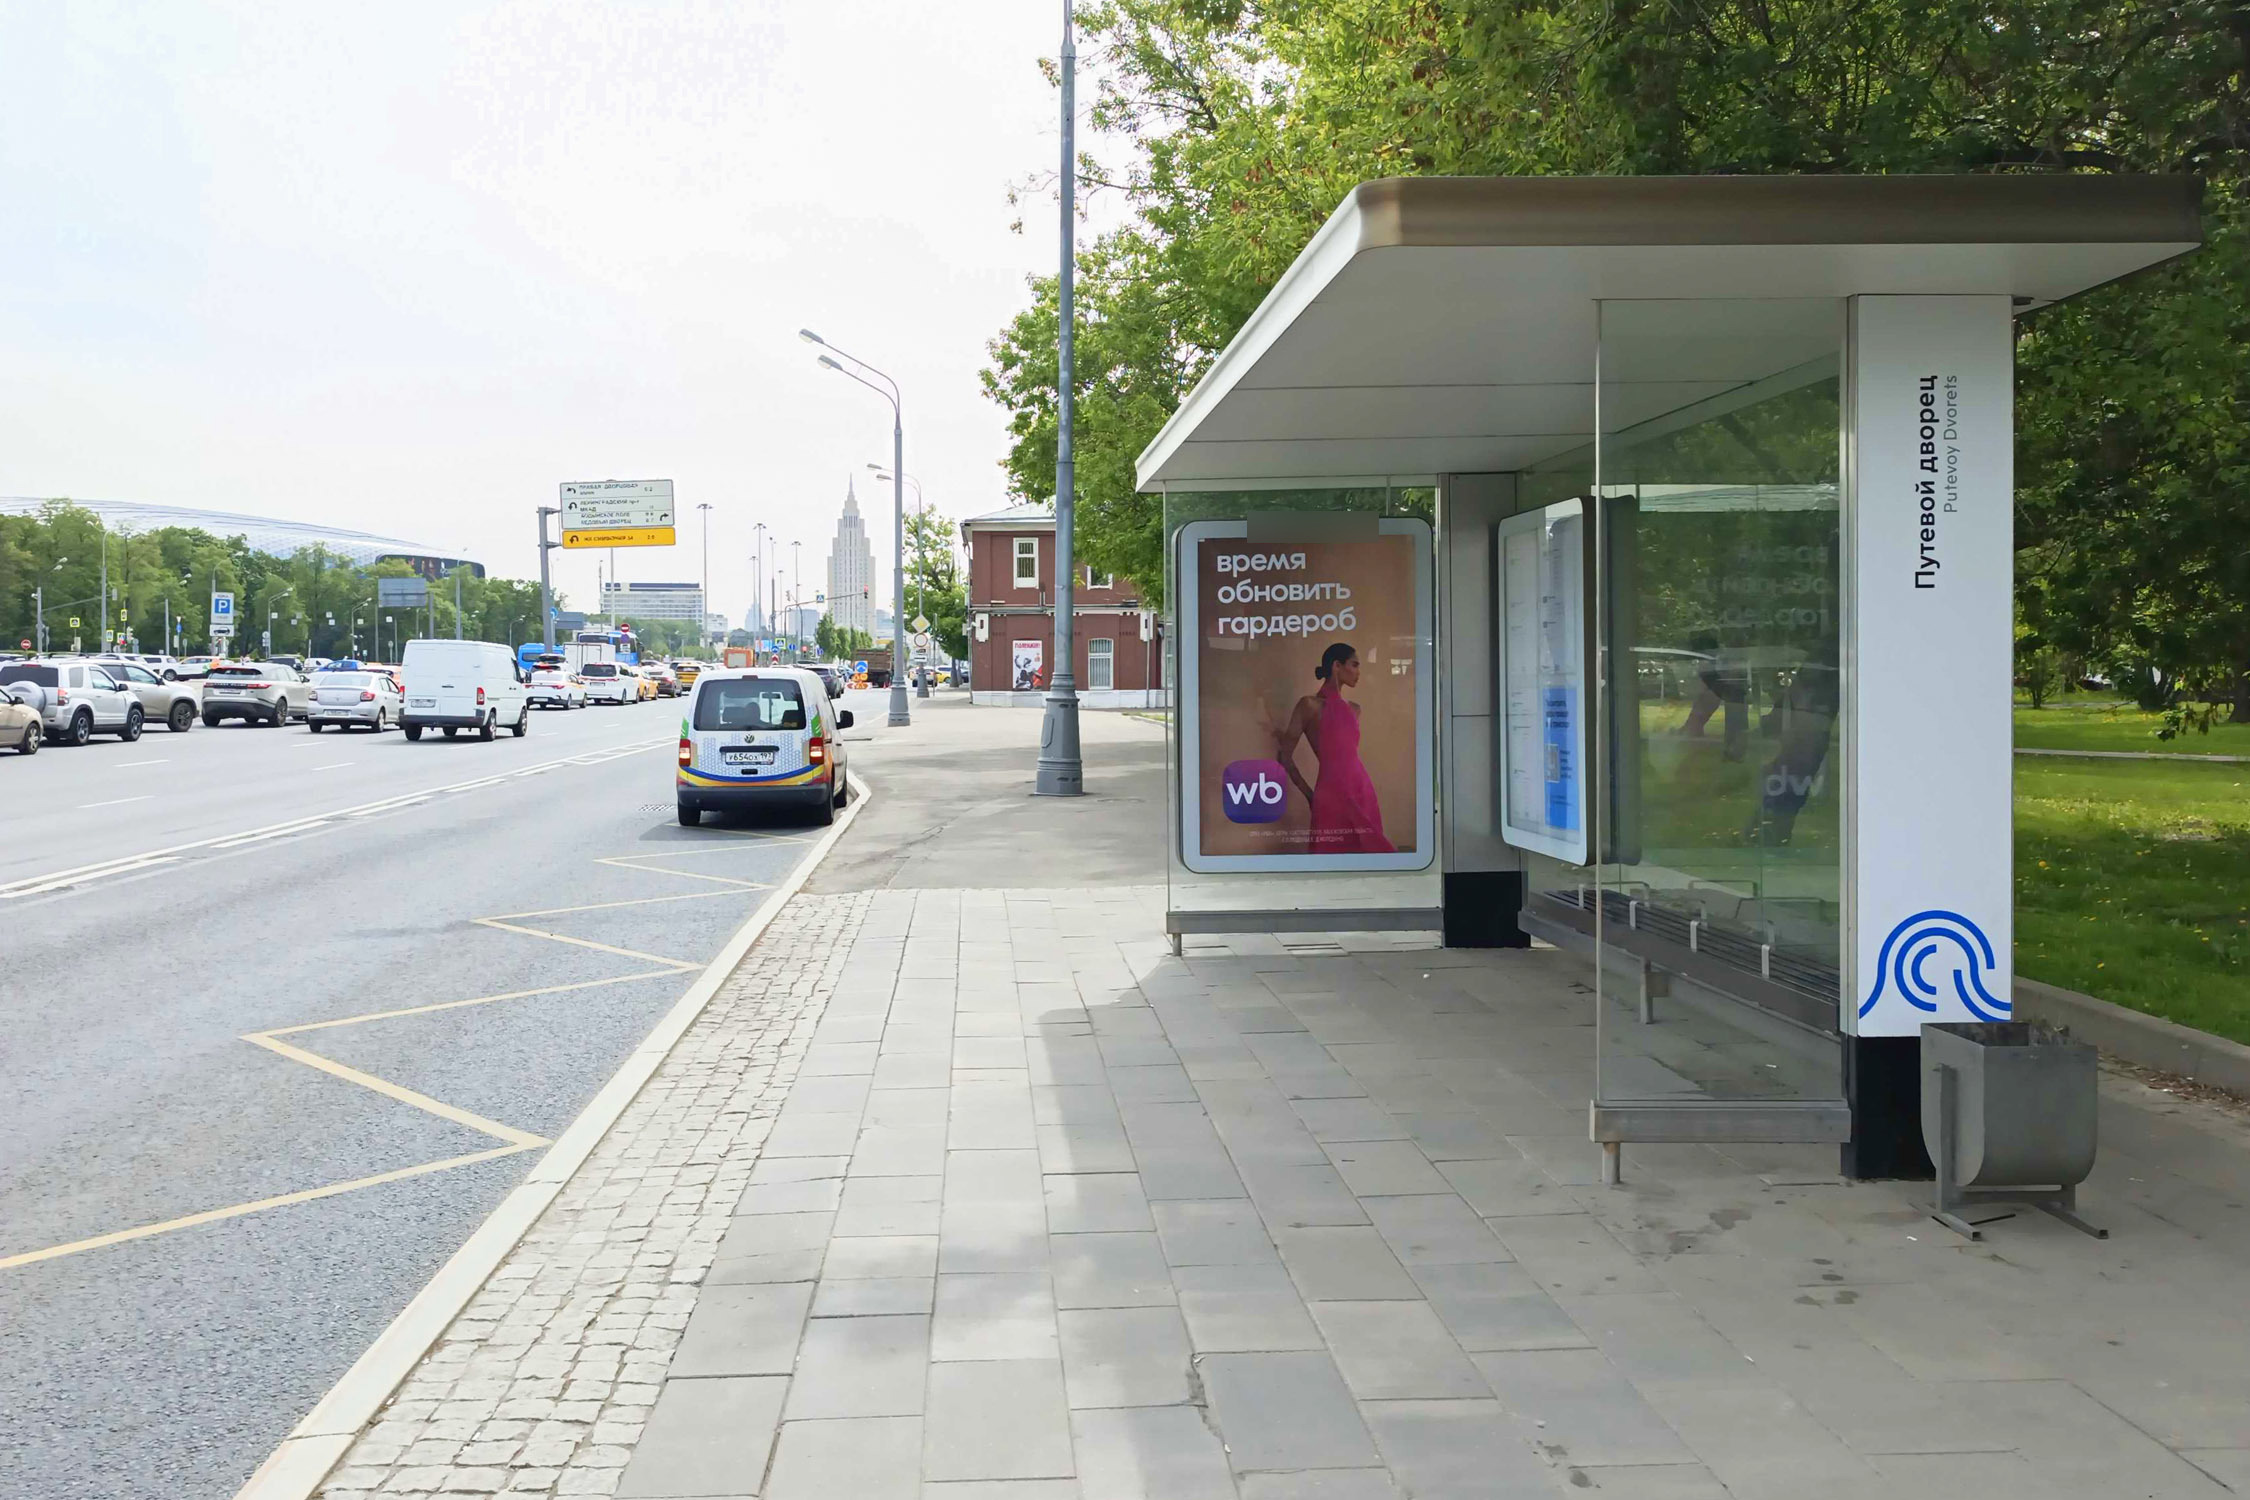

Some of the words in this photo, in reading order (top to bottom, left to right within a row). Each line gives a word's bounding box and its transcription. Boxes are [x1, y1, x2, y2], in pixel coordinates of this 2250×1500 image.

[1919, 375, 1940, 473] дворец
[1943, 375, 1957, 440] Dvorets
[1943, 445, 1960, 513] Putevoy
[1915, 480, 1940, 589] Путевой
[1217, 552, 1306, 577] время
[1217, 579, 1351, 604] обновить
[1217, 607, 1357, 639] гардероб
[1226, 772, 1283, 805] wb
